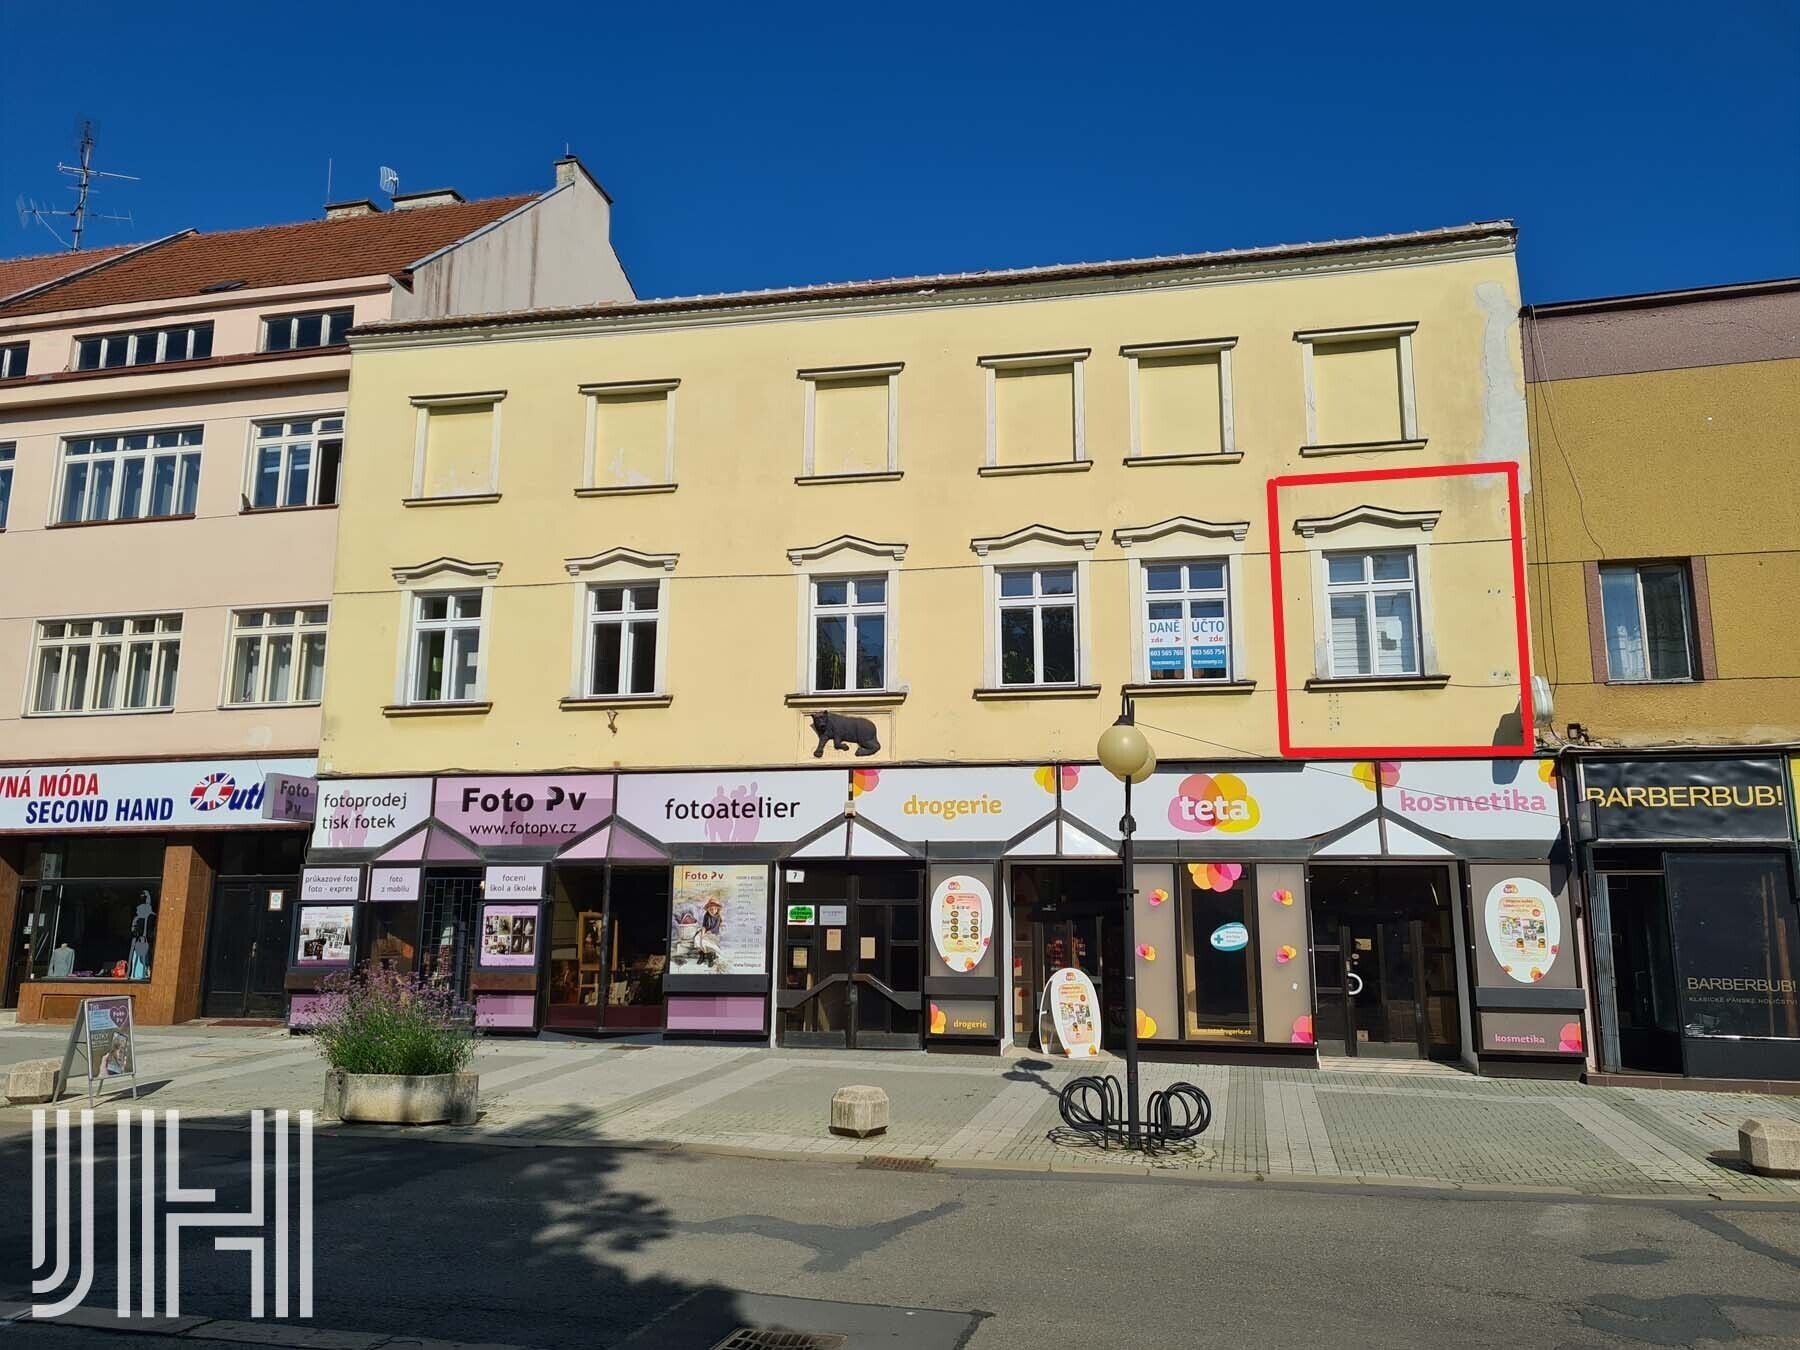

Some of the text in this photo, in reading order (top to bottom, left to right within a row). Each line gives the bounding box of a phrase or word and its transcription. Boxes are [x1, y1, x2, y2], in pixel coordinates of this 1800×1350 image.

[1208, 634, 1224, 642] zde
[38, 768, 99, 797] MÓDA
[280, 780, 310, 798] Foto
[324, 791, 407, 810] fotoprodej
[461, 787, 534, 812] Foto
[1399, 789, 1547, 812] kosmetika
[1585, 785, 1784, 808] BARBERBUB!
[25, 797, 174, 824] SECOND HAND
[665, 796, 800, 820] fotoatelier
[903, 794, 1003, 820] drogerie
[1179, 795, 1251, 821] teta
[322, 813, 396, 829] tisk fotek
[469, 821, 577, 837] www.fotopv.cz
[343, 874, 358, 882] foto
[389, 875, 403, 883] foto
[684, 871, 708, 880] Foto
[793, 872, 798, 880] 7
[308, 885, 323, 893] foto
[329, 886, 353, 894] expres
[1687, 977, 1797, 993] BARBERBUB!
[953, 1019, 987, 1030] drogerie
[1495, 1033, 1545, 1044] kosmetika
